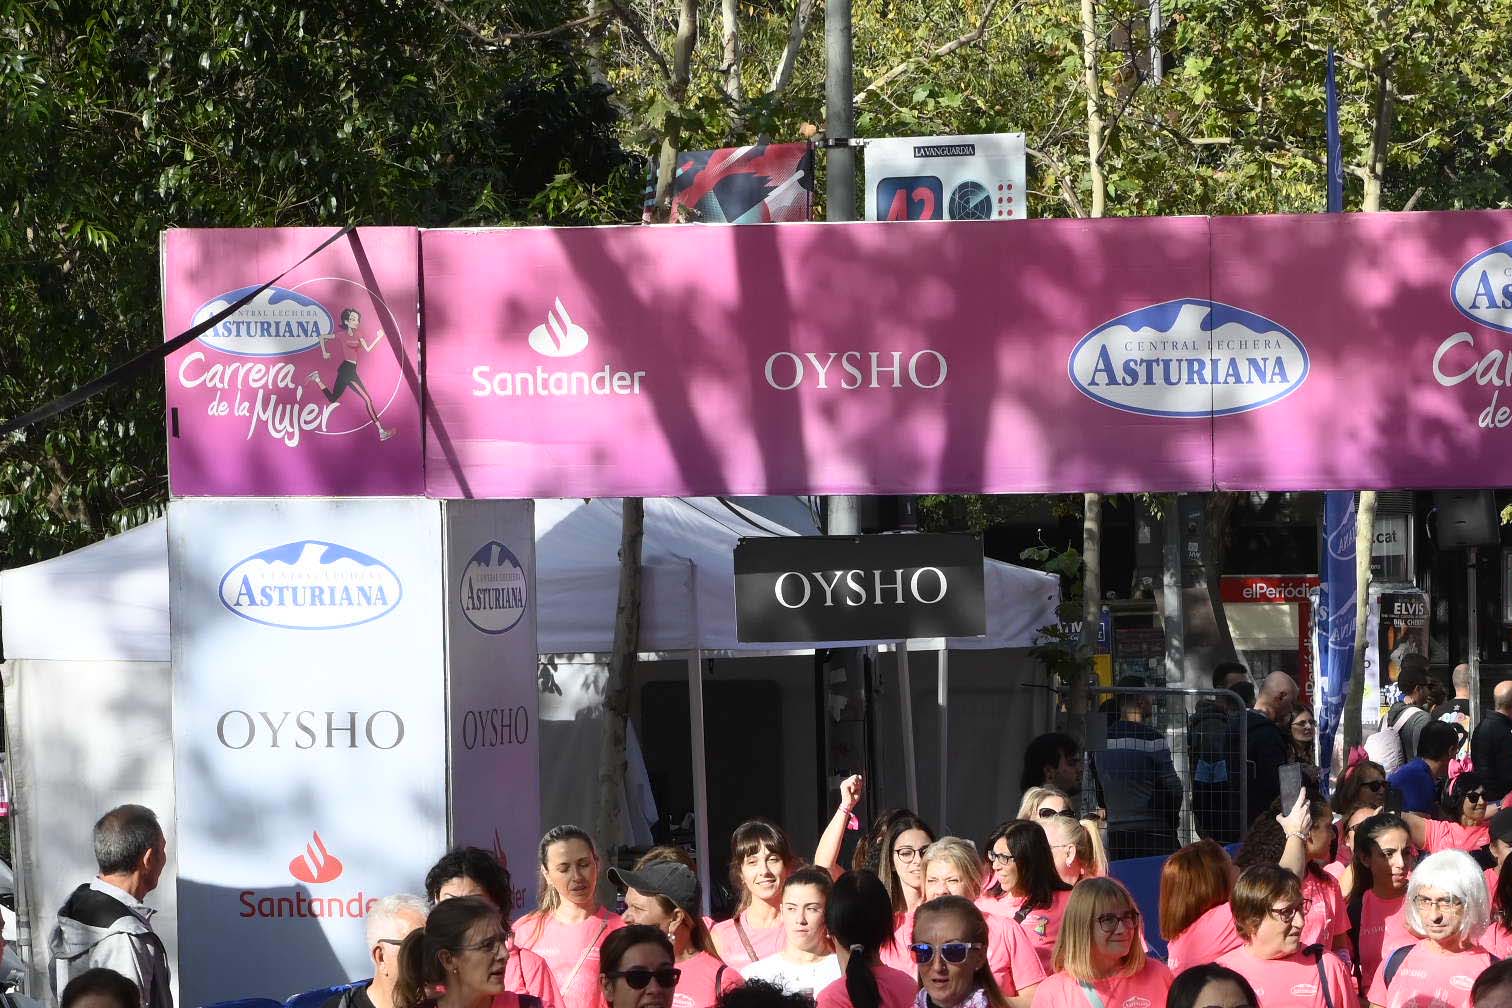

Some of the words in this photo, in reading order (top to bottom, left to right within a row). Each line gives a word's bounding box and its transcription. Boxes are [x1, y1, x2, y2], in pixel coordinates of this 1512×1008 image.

[925, 145, 975, 156] VANGUARDIA
[1087, 343, 1290, 387] ASTURIANA
[1124, 341, 1200, 352] CENTRAL
[1208, 339, 1282, 351] LECHERA
[178, 351, 303, 389] Carrera
[472, 363, 646, 397] Santander
[764, 348, 949, 391] OYSHO
[207, 389, 230, 417] de
[234, 392, 250, 417] la
[247, 386, 341, 448] Mujer
[1478, 389, 1512, 430] de
[233, 573, 389, 607] ASTURIANA
[465, 575, 523, 611] ASTURIANA
[774, 566, 948, 609] OYSHO
[1393, 602, 1424, 615] ELVIS
[216, 710, 406, 750] OYSHO
[462, 705, 529, 751] OYSHO
